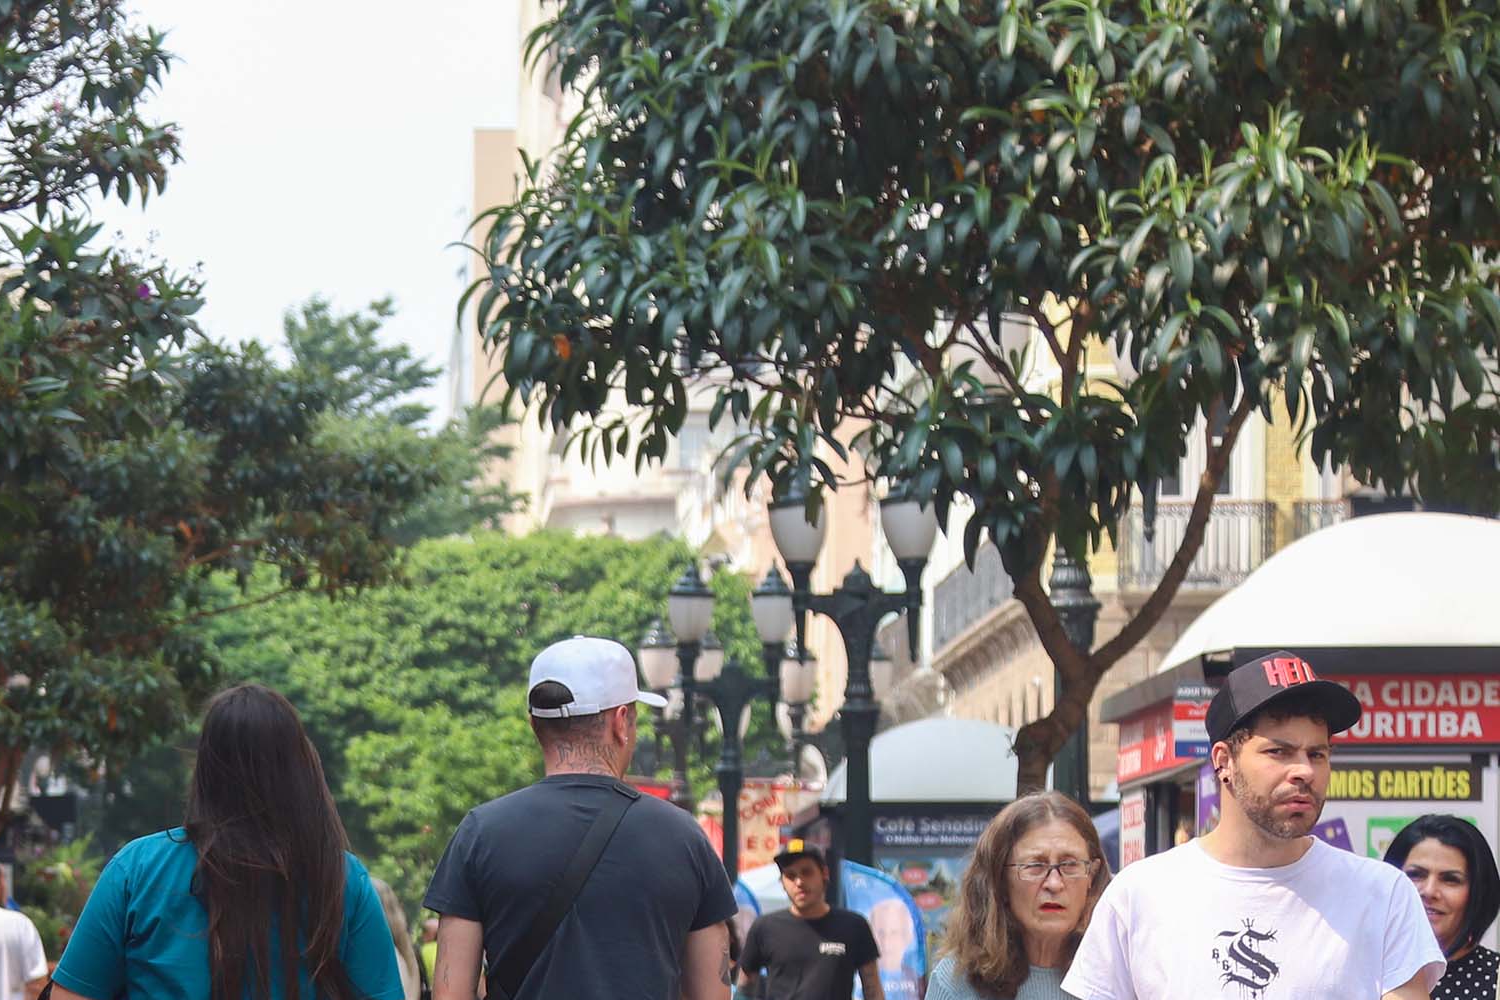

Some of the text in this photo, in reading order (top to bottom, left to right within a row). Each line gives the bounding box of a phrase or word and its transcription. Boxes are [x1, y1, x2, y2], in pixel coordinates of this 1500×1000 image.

[1380, 680, 1500, 707] CIDADE
[1334, 711, 1483, 738] URITIBA
[1379, 766, 1471, 799] CARTÕES
